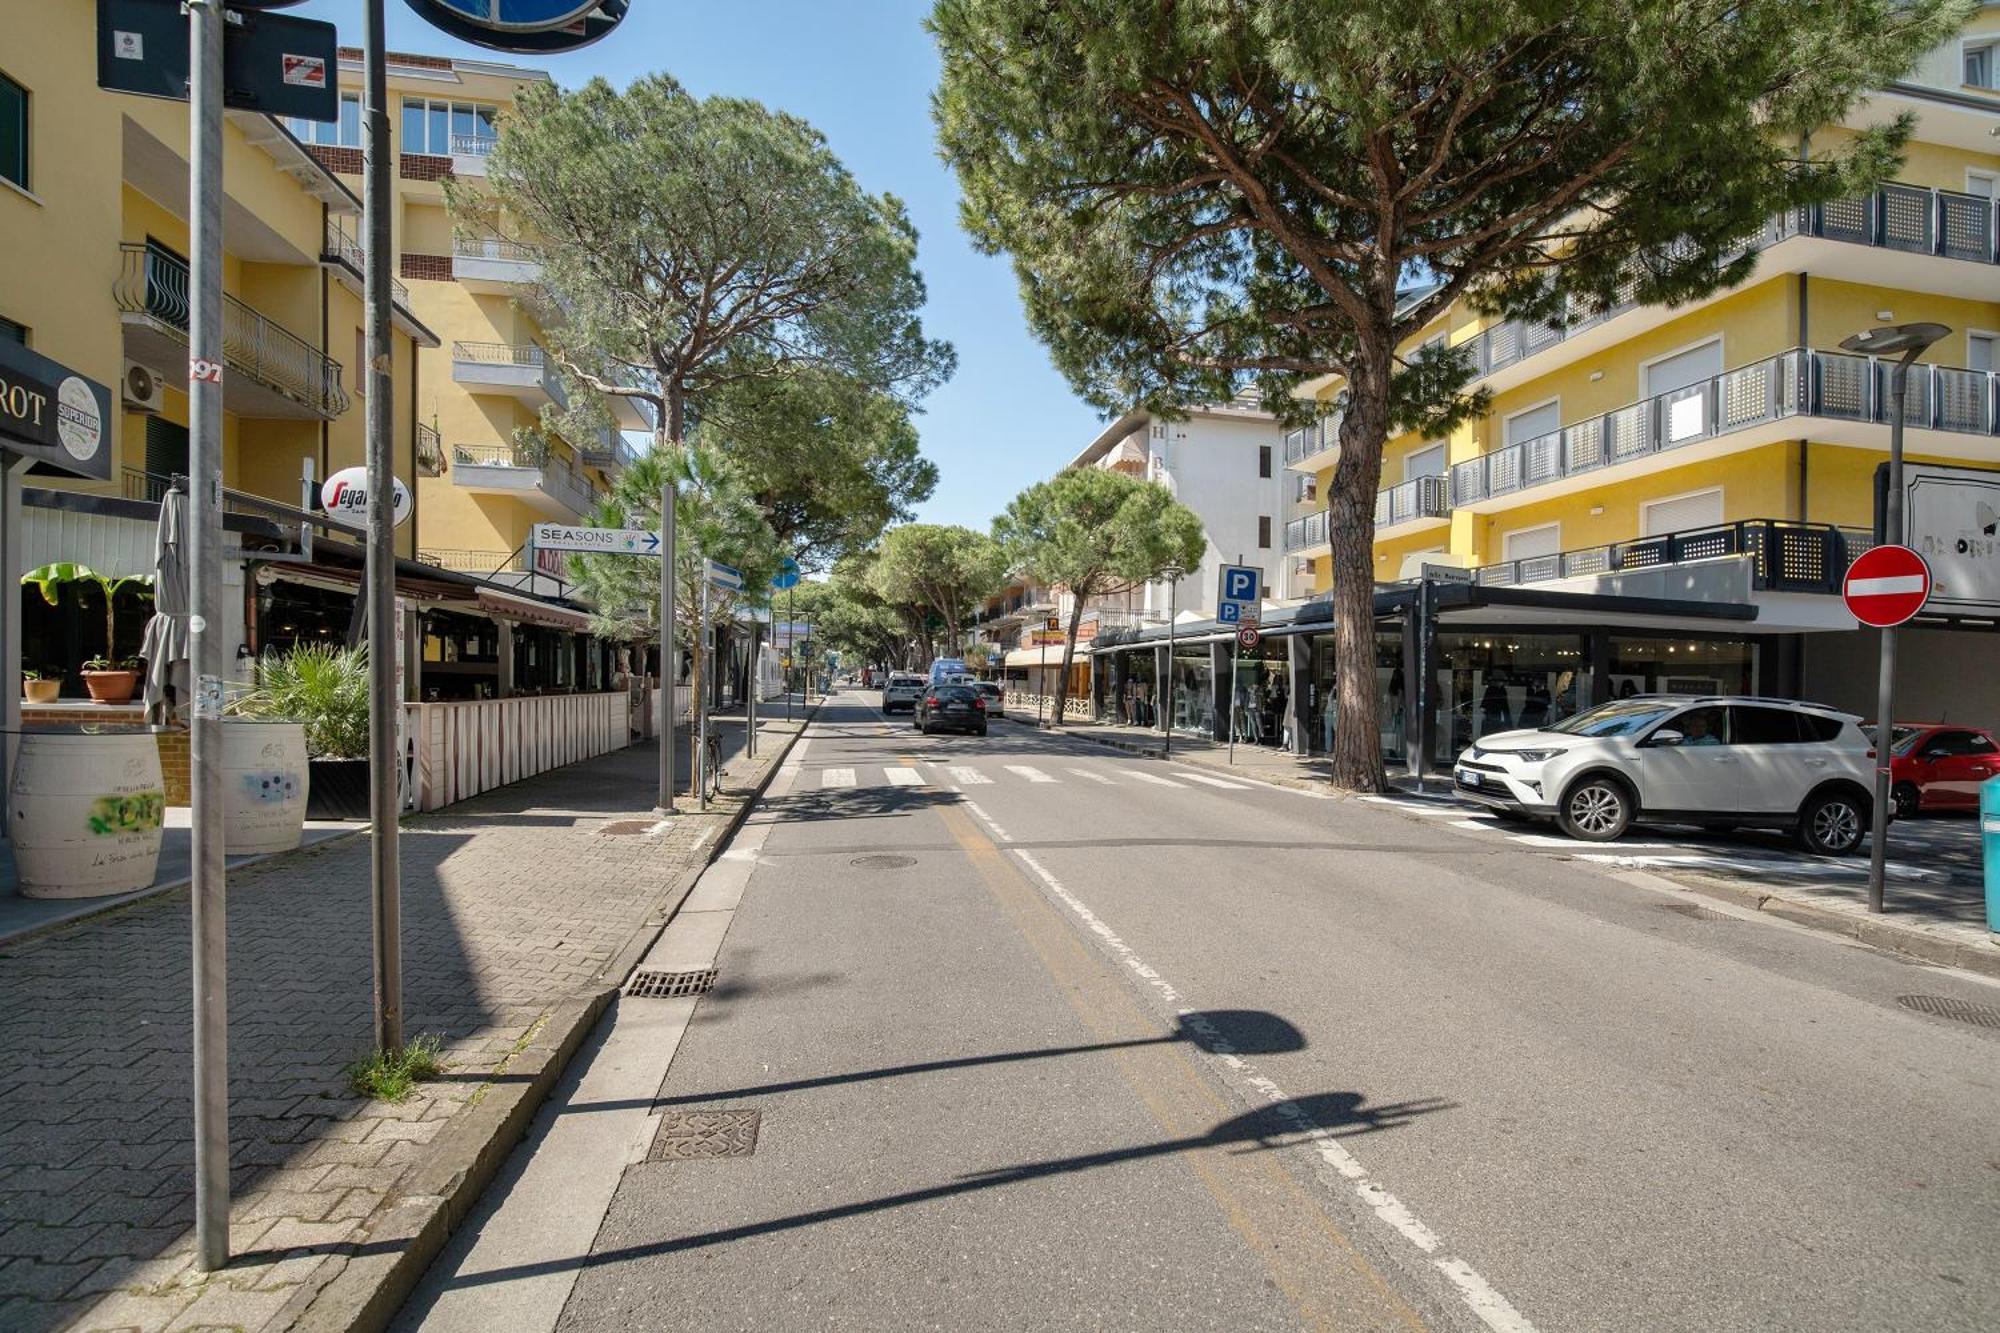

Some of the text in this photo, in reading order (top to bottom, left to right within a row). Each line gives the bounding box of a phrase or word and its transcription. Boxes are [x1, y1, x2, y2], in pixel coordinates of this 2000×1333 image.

[58, 404, 100, 433] SUPERIOR
[327, 480, 403, 510] Segao
[540, 528, 614, 544] SEASONS
[1232, 573, 1250, 596] P
[1224, 604, 1236, 619] P
[1243, 632, 1255, 641] 30
